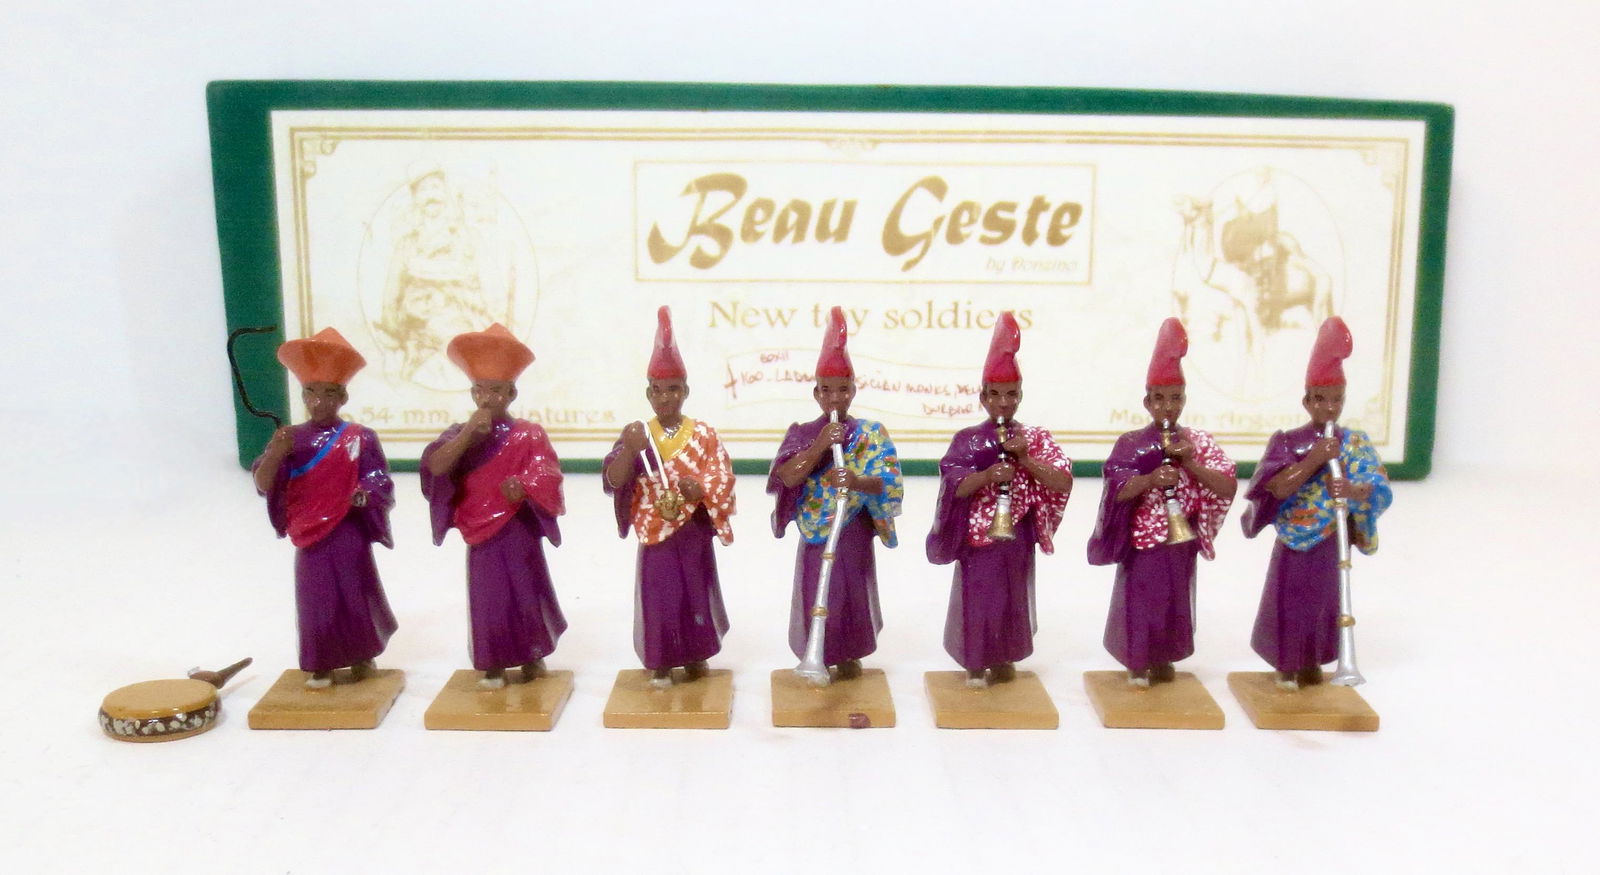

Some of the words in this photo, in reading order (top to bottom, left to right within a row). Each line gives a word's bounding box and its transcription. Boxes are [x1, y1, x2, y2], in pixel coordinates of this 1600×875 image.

[648, 173, 858, 270] Beau
[882, 176, 1083, 272] Geste
[708, 301, 797, 329] New
[359, 405, 392, 425] 54
